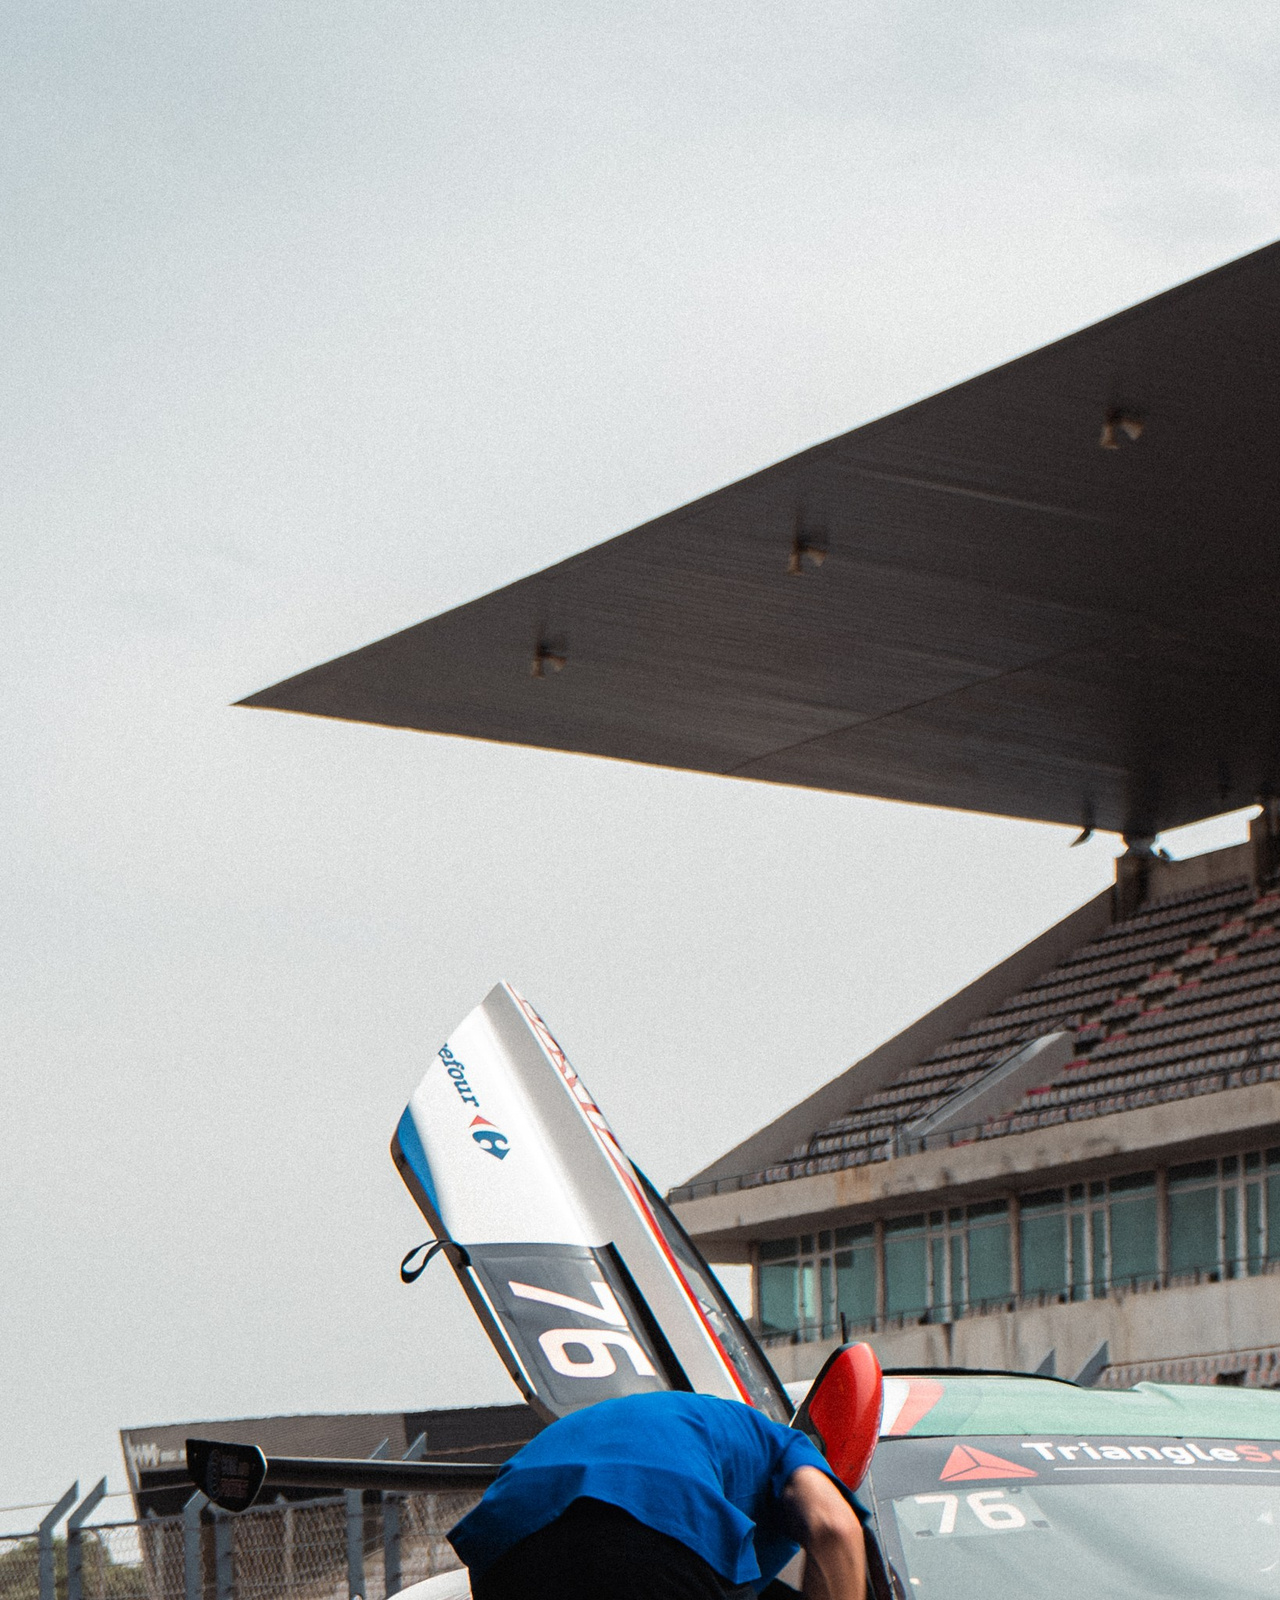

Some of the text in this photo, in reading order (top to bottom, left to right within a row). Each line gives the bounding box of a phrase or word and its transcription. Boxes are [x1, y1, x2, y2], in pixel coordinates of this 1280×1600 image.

[438, 1043, 479, 1107] efour
[508, 1281, 656, 1378] 76
[915, 1490, 1026, 1533] 76
